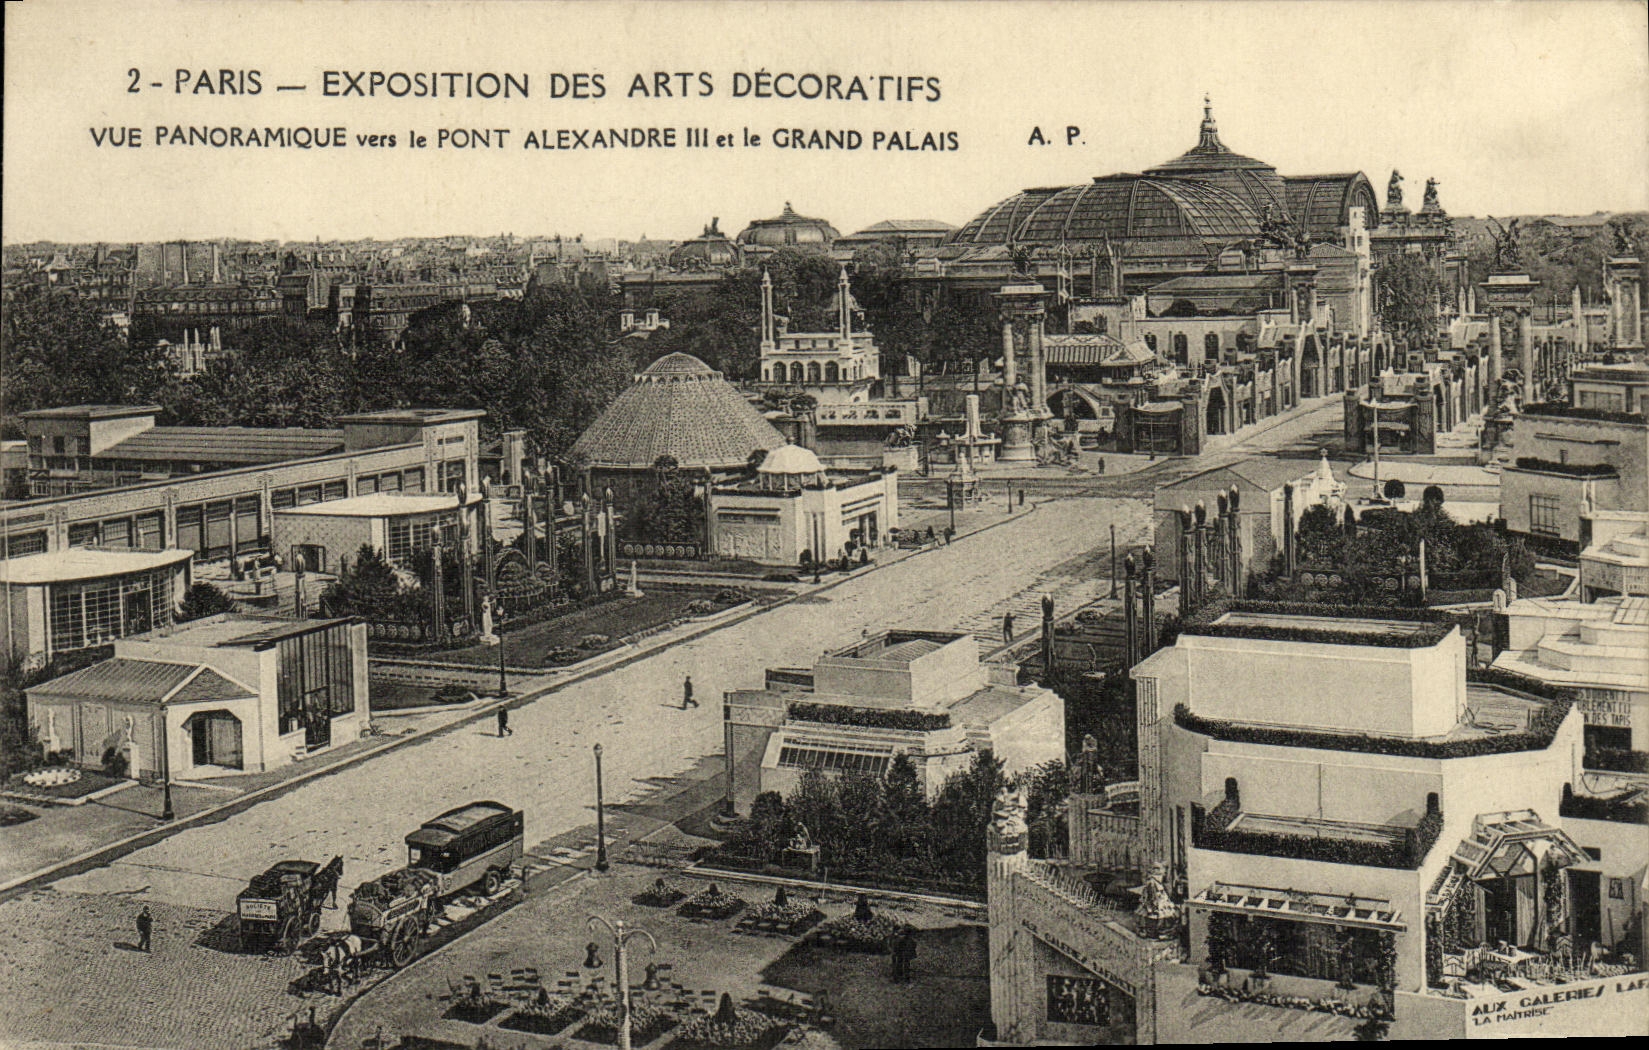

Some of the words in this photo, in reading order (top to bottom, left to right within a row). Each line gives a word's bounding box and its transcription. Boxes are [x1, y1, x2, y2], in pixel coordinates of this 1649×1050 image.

[1611, 714, 1631, 727] TAPIS
[1472, 1000, 1507, 1016] AUX
[1519, 984, 1605, 1008] GALERIES
[1616, 978, 1649, 993] LAF
